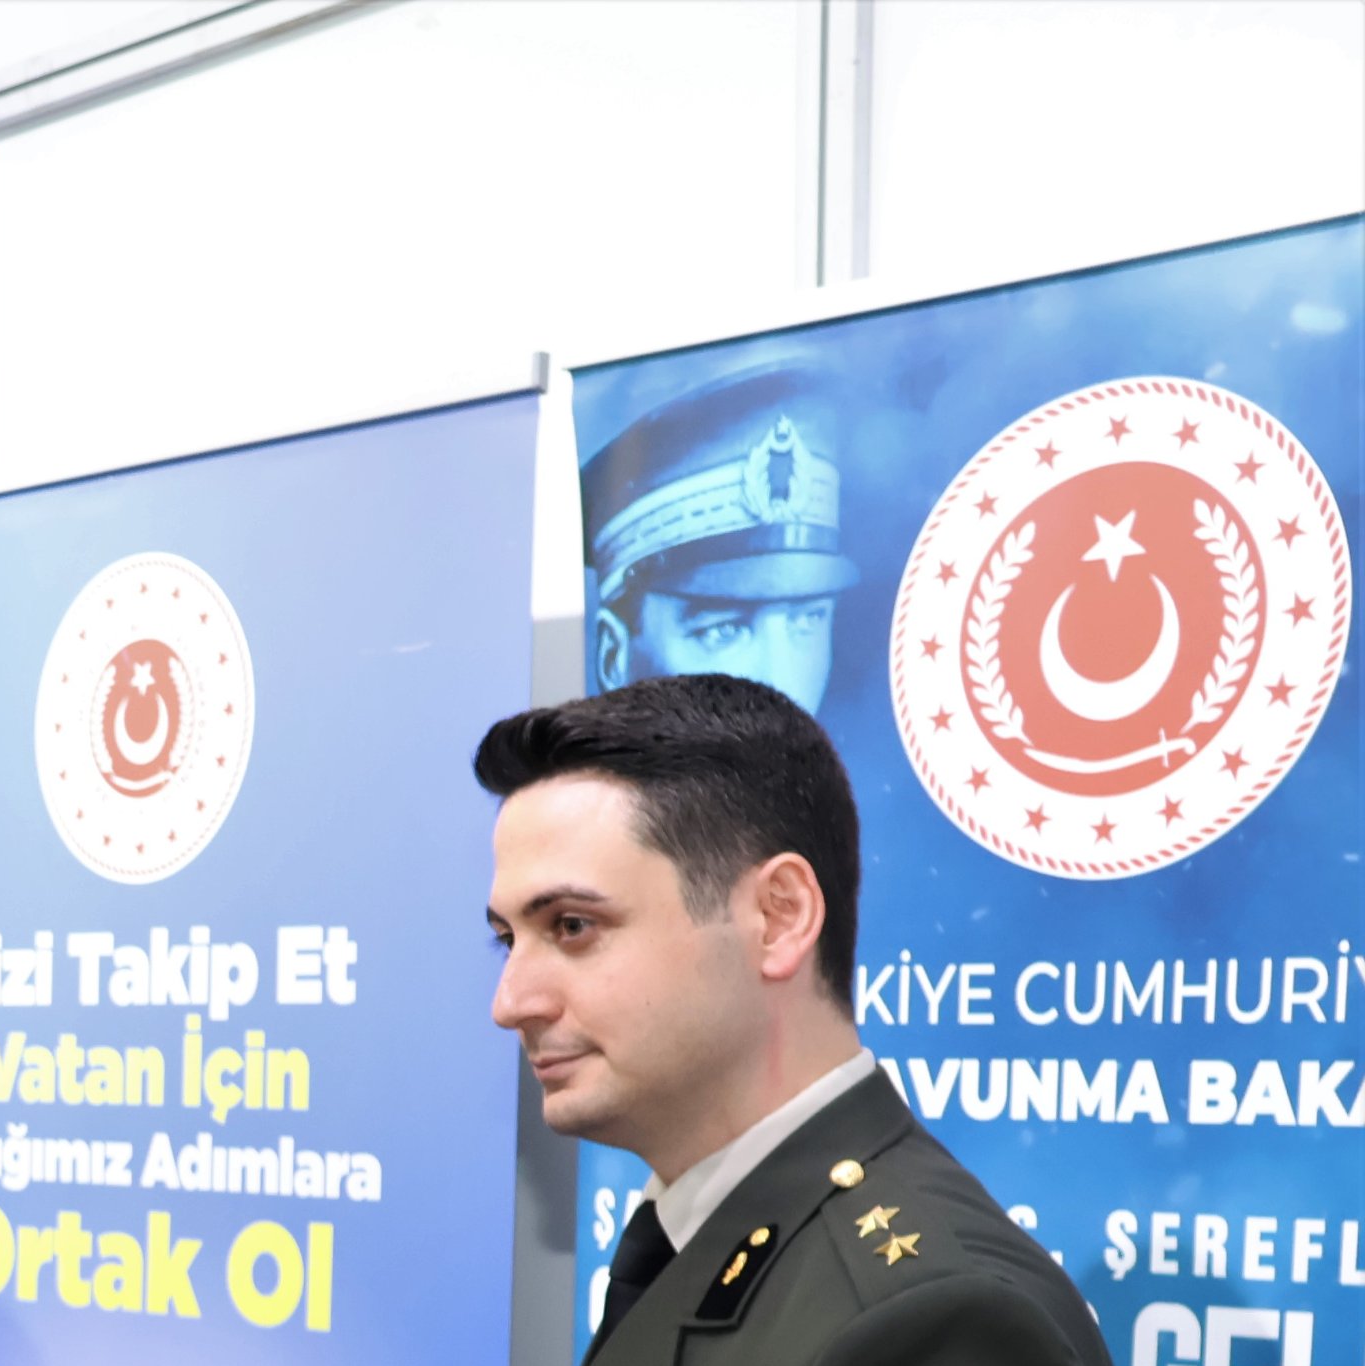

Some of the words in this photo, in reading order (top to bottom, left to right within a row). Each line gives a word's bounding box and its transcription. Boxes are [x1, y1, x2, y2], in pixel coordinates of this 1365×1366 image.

[68, 926, 259, 1021] Takip
[275, 925, 358, 1005] Et
[855, 947, 997, 1027] KİYE
[182, 1013, 311, 1124] İçin
[1186, 1058, 1365, 1128] BAK
[140, 1132, 382, 1201] Adımlara
[226, 1219, 335, 1332] Ol
